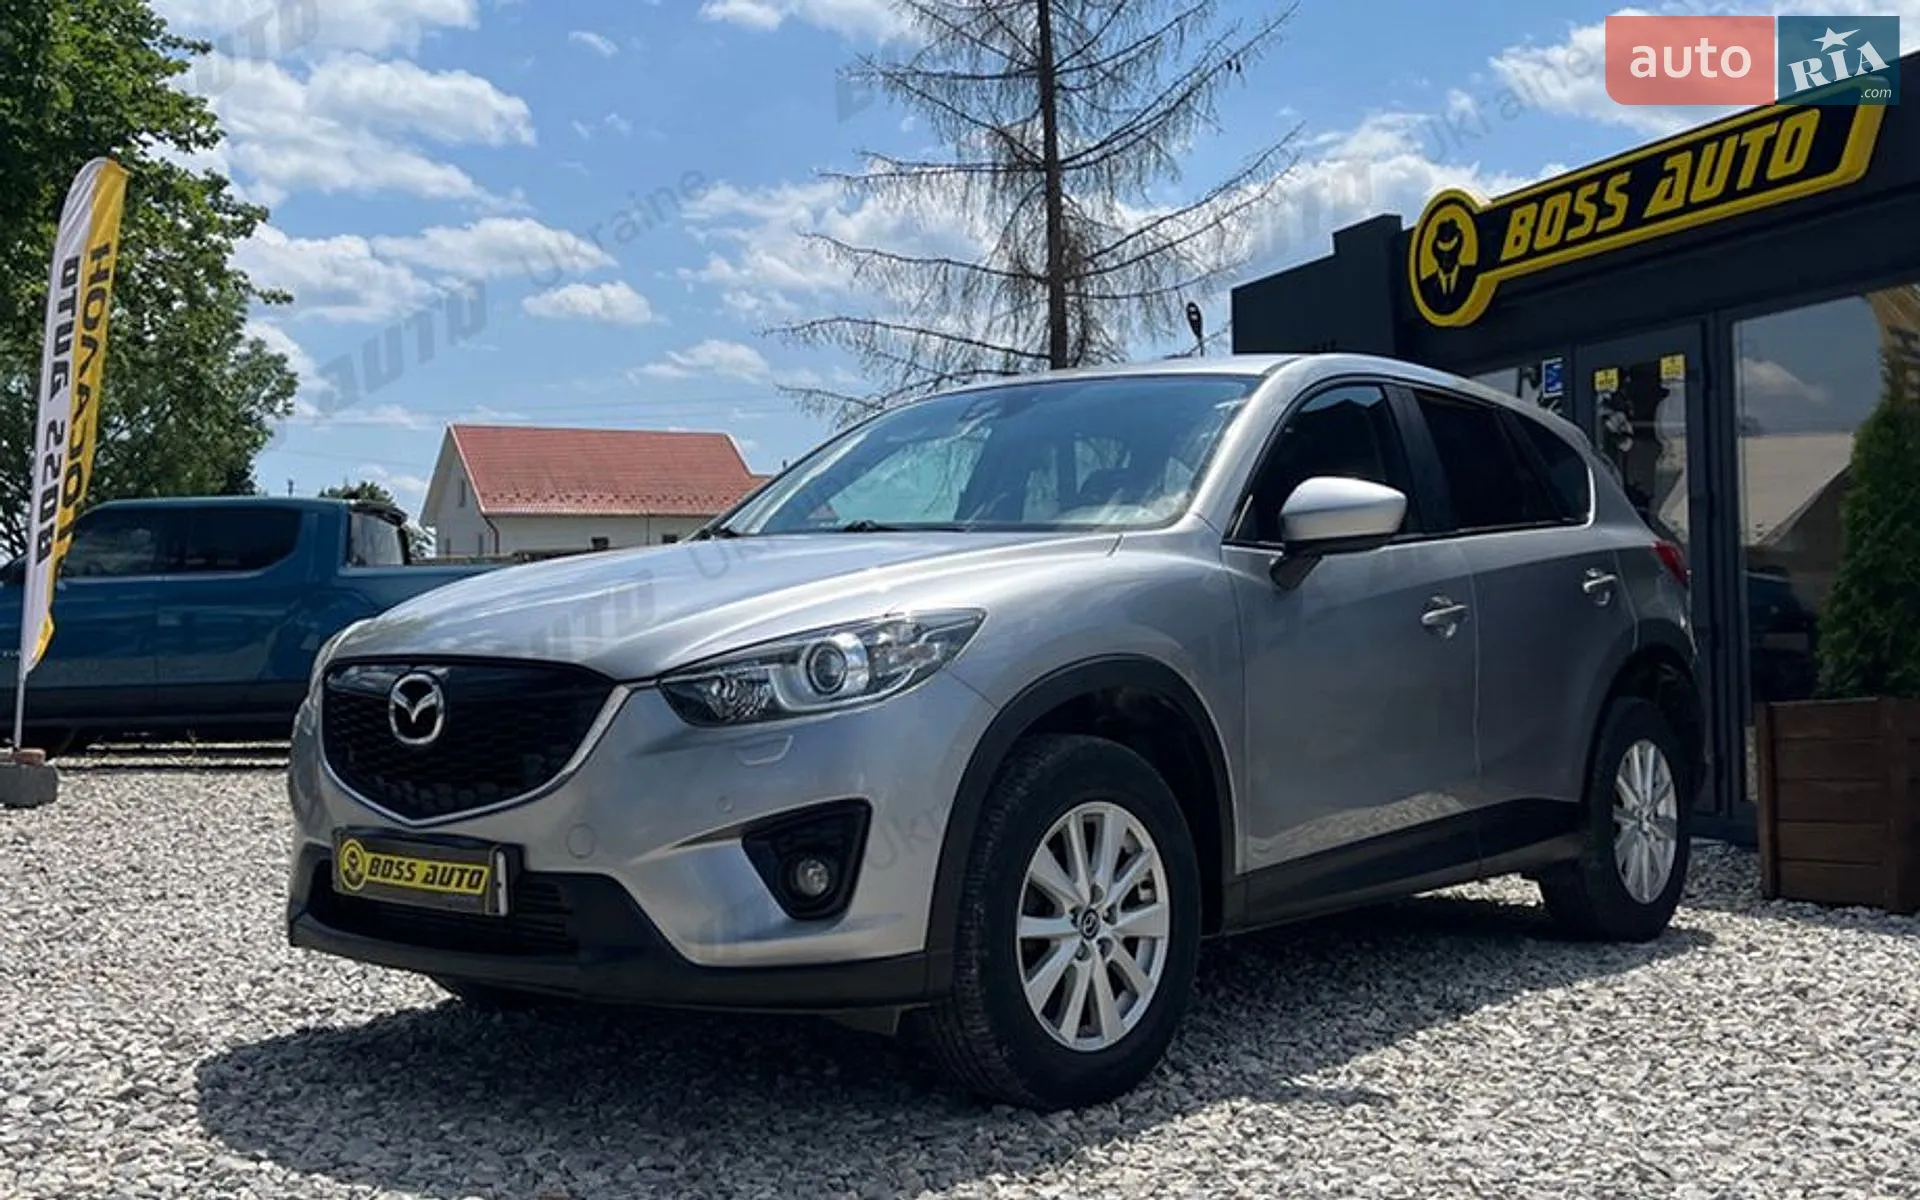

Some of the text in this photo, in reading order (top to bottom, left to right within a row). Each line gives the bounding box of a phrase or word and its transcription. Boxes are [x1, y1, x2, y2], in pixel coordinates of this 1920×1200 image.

[1501, 108, 1821, 261] BOSS AUTO
[368, 857, 484, 890] BOSS AUTO
